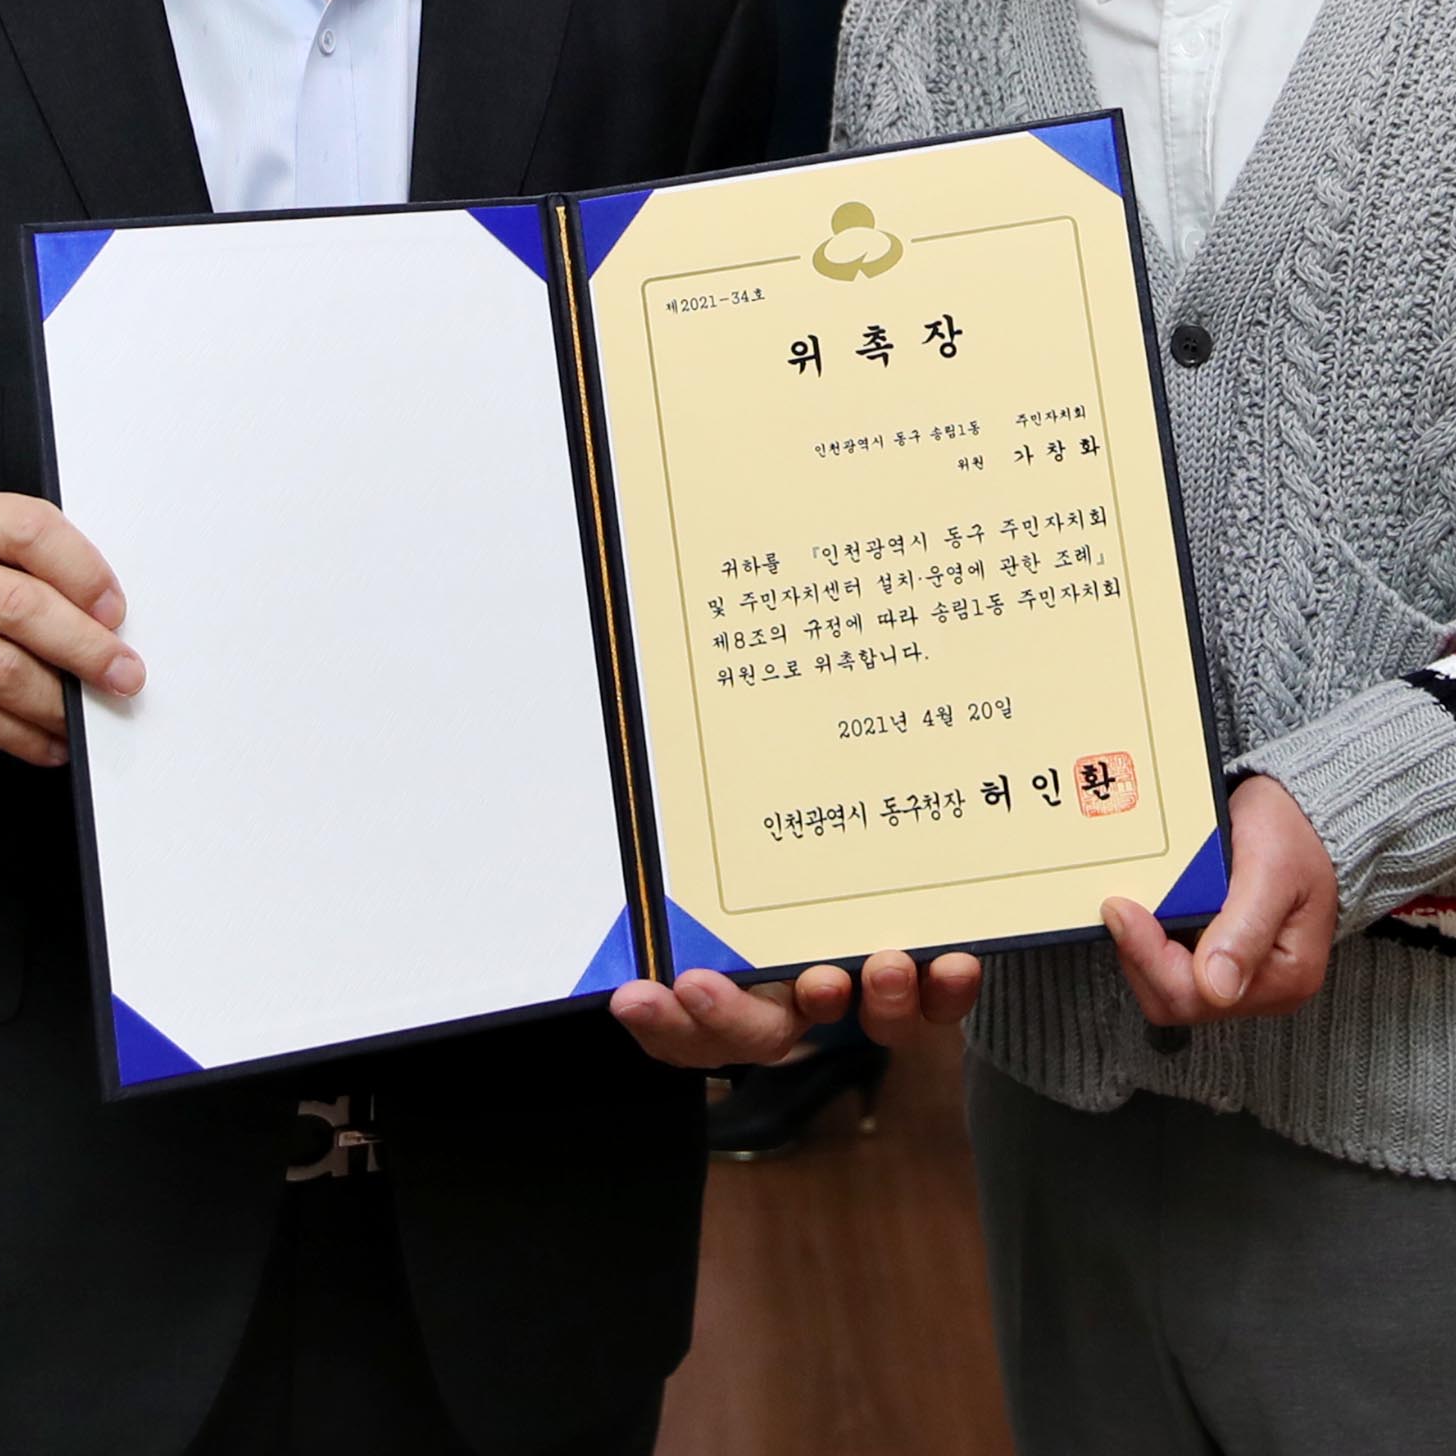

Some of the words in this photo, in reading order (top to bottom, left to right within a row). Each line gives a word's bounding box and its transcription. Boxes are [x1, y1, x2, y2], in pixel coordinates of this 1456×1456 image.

[665, 287, 766, 314] 제2021-34호
[814, 434, 884, 459] 인천광역시
[893, 429, 921, 447] 동구
[929, 420, 981, 442] 송림1동
[1015, 404, 1086, 428] 주민자치회
[957, 454, 984, 471] 위원
[720, 552, 781, 580] 귀하를
[943, 523, 985, 550] 동구
[999, 505, 1107, 540] 주민자치회
[707, 595, 726, 619] 및
[739, 576, 862, 613] 주민자치센터
[999, 551, 1041, 578] 관한
[712, 623, 787, 653] 제8조의
[802, 612, 863, 641] 규정에
[876, 605, 919, 629] 따라
[930, 592, 1005, 624] 송림1동
[1017, 576, 1121, 611] 주민자치회
[716, 659, 803, 688] 위원으로
[814, 641, 929, 674] 위촉합니다.
[837, 710, 908, 740] 2021년
[922, 704, 953, 728] 4월
[967, 696, 1013, 722] 20일
[763, 800, 868, 842] 인천광역시
[879, 788, 967, 827] 동구청장
